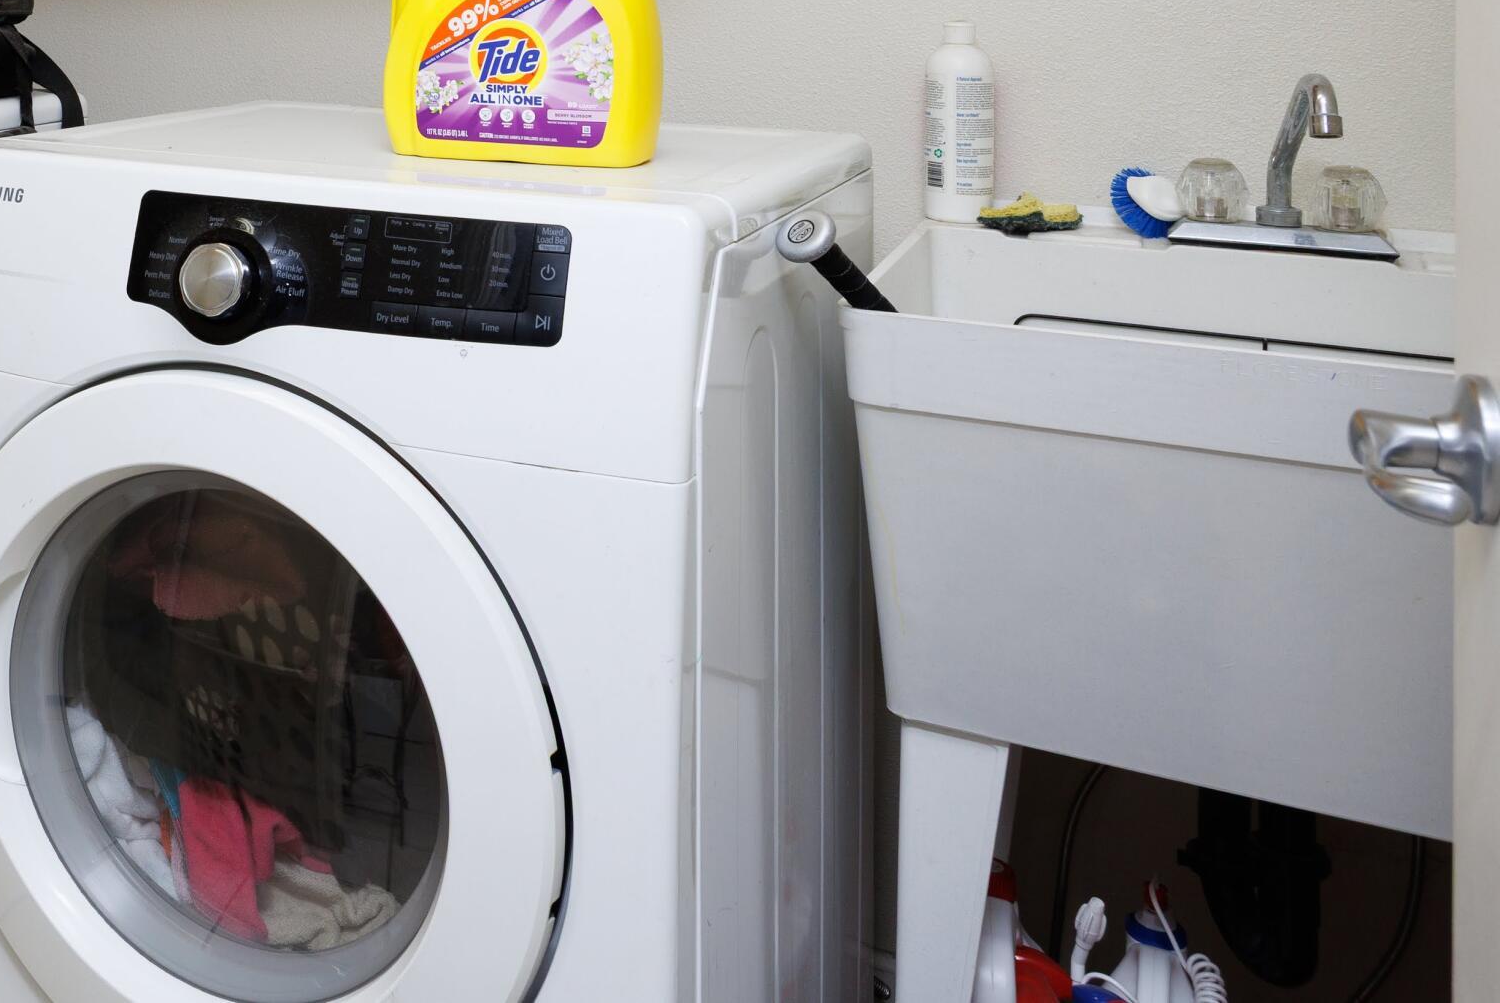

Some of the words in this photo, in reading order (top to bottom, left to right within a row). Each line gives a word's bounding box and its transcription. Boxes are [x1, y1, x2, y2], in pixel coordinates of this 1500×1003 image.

[478, 39, 540, 83] Tide
[485, 84, 528, 94] SIMPLY
[470, 93, 496, 104] ALL
[498, 94, 511, 105] IN
[512, 95, 543, 106] ONE
[353, 227, 363, 236] Up
[541, 227, 564, 237] Mixed
[168, 236, 188, 245] Normal
[536, 235, 554, 244] Load
[554, 236, 568, 245] Bell
[270, 246, 287, 256] Time
[287, 248, 301, 260] Dry
[392, 244, 407, 252] More
[407, 245, 417, 254] Dry
[441, 248, 455, 256] High
[149, 251, 165, 260] Heavy
[165, 252, 178, 262] Duty
[345, 254, 363, 263] Down
[275, 261, 303, 274] Wrinkle
[391, 257, 411, 266] Normal
[411, 259, 421, 269] Dry
[439, 262, 462, 270] Medium
[276, 270, 304, 282] Release
[401, 273, 411, 281] Dry
[275, 285, 288, 294] Air
[288, 287, 306, 298] Fluff
[387, 285, 403, 294] Damp
[403, 286, 414, 296] Dry
[436, 289, 451, 298] Extra
[376, 312, 390, 323] Dry
[391, 314, 410, 324] Level
[431, 317, 453, 328] Temp.
[481, 323, 500, 333] Time
